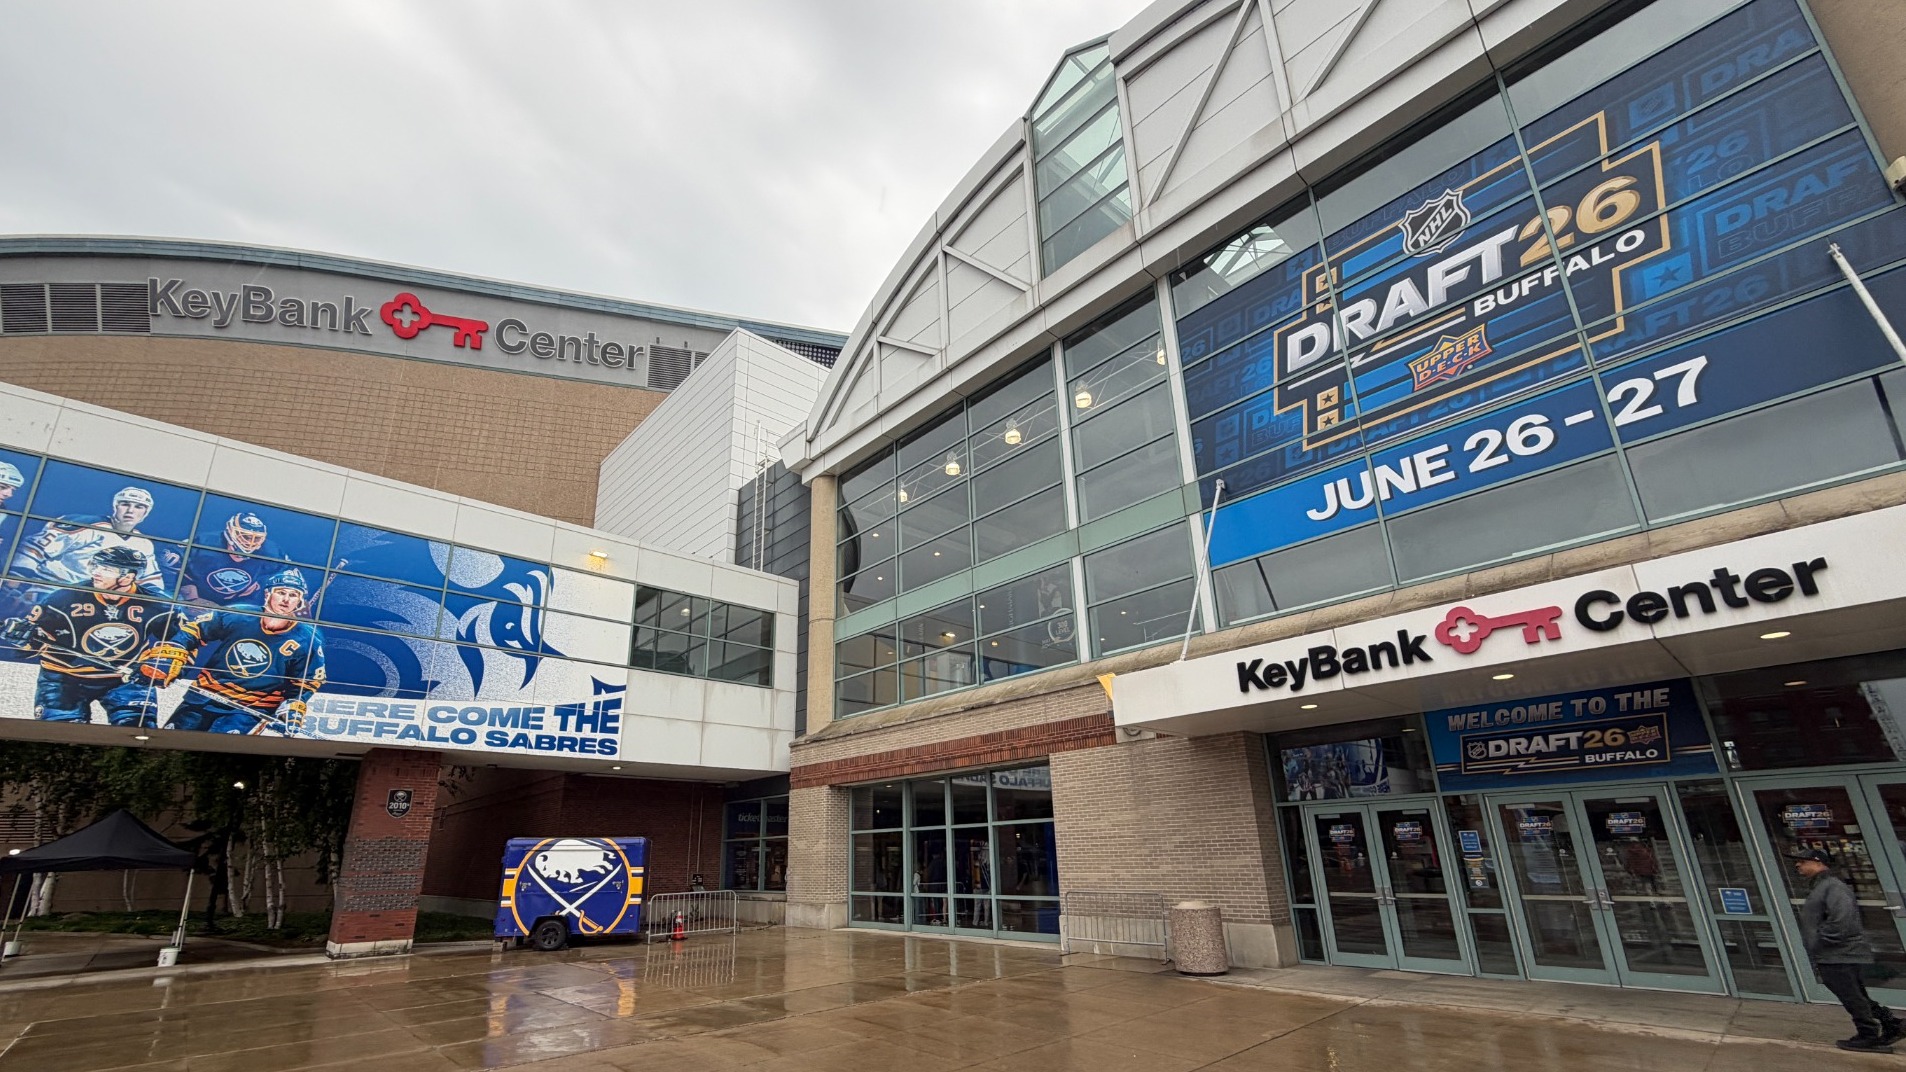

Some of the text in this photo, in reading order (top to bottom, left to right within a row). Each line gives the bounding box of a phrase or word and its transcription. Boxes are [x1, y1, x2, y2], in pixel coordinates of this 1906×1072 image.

[1417, 205, 1454, 248] NHL
[1474, 228, 1646, 318] BUFFALO
[147, 276, 646, 370] KeyBank Center
[1416, 333, 1480, 374] UPPER
[1305, 443, 1456, 521] JUNE
[1463, 414, 1555, 474] 26
[1606, 355, 1709, 428] 27
[70, 603, 95, 618] 29
[127, 605, 144, 623] C
[1236, 628, 1434, 694] KeyBank
[1574, 556, 1829, 632] Center
[279, 639, 301, 657] C
[427, 705, 546, 731] COME
[554, 697, 623, 735] THE
[1447, 687, 1671, 732] WELCOME TO THE
[302, 714, 477, 746] BUFFALO
[484, 730, 618, 756] SABRES
[1584, 748, 1659, 764] BUFFALO
[738, 812, 788, 823] ticketaster
